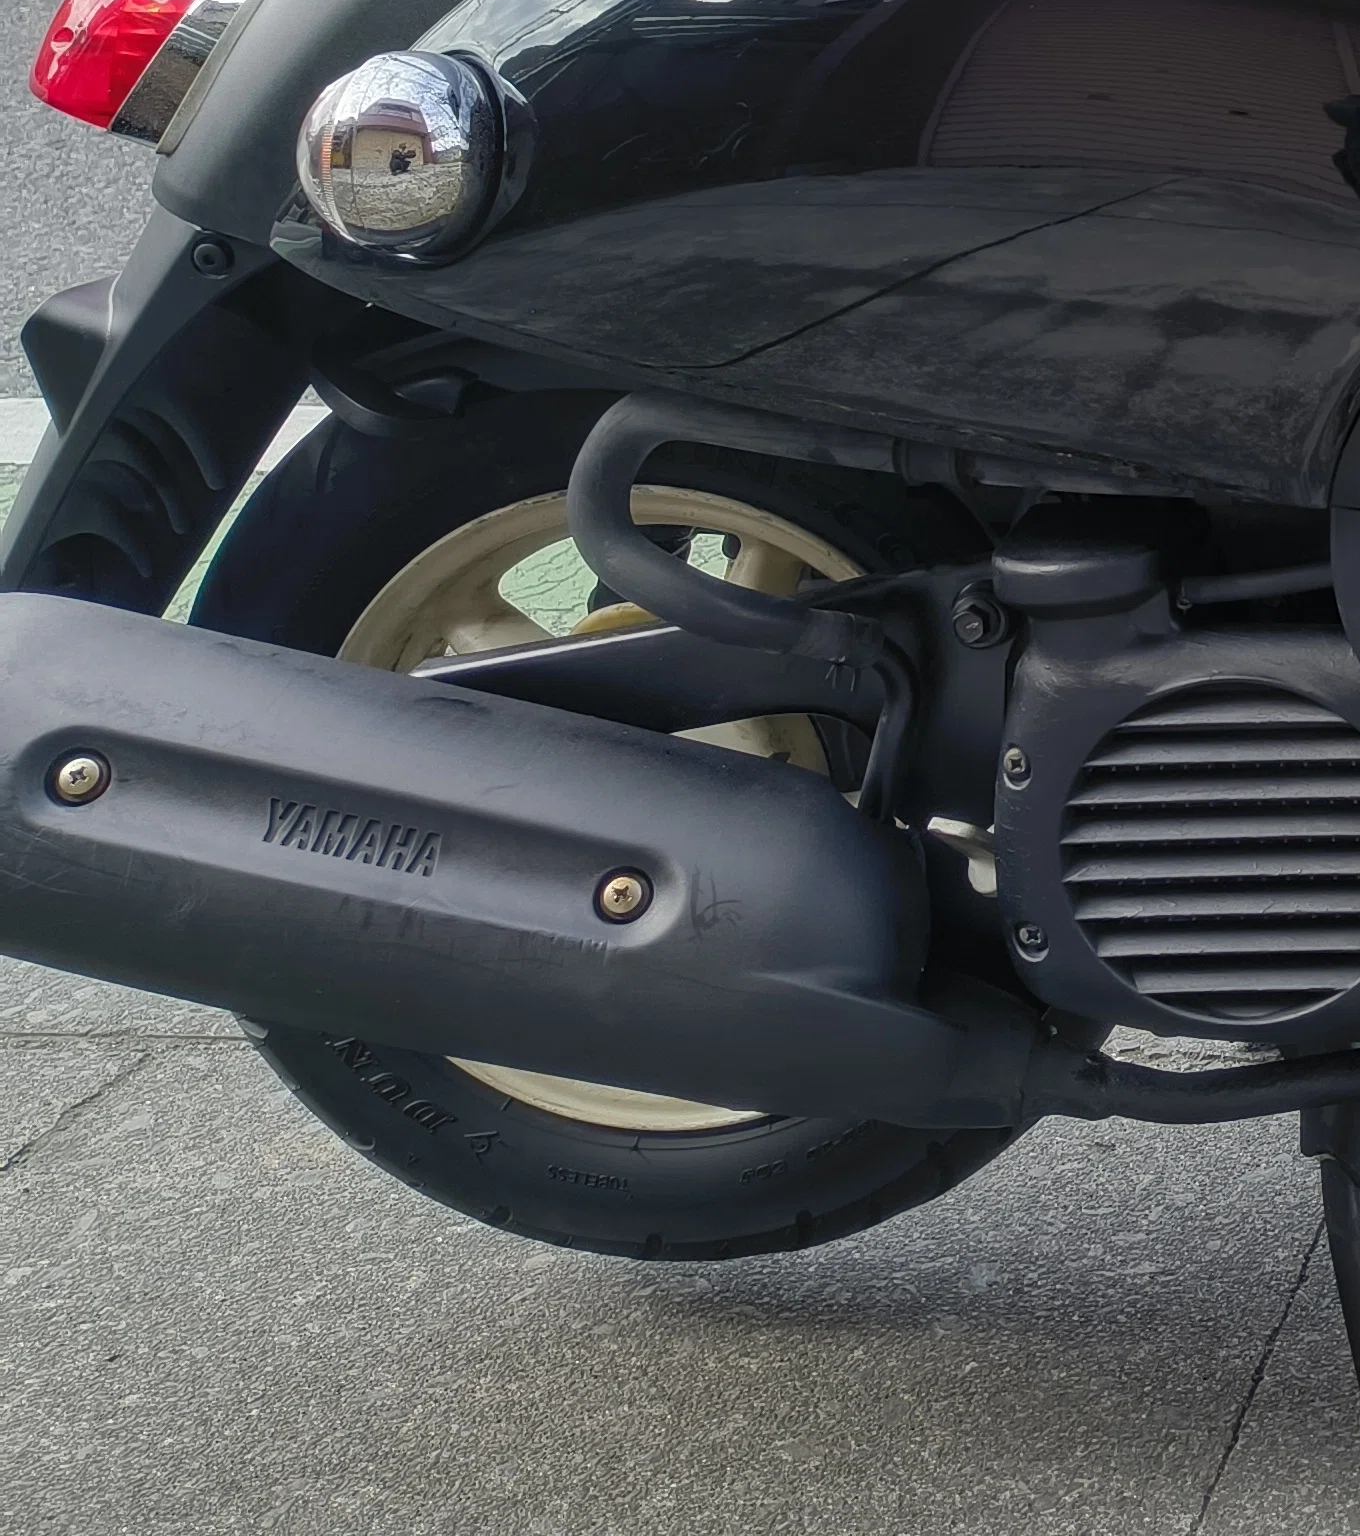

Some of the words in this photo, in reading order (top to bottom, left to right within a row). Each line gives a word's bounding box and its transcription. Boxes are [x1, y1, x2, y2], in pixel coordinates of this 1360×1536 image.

[262, 797, 443, 878] YAMAHA
[326, 1030, 458, 1134] DUN
[546, 1163, 630, 1193] TUBELESS
